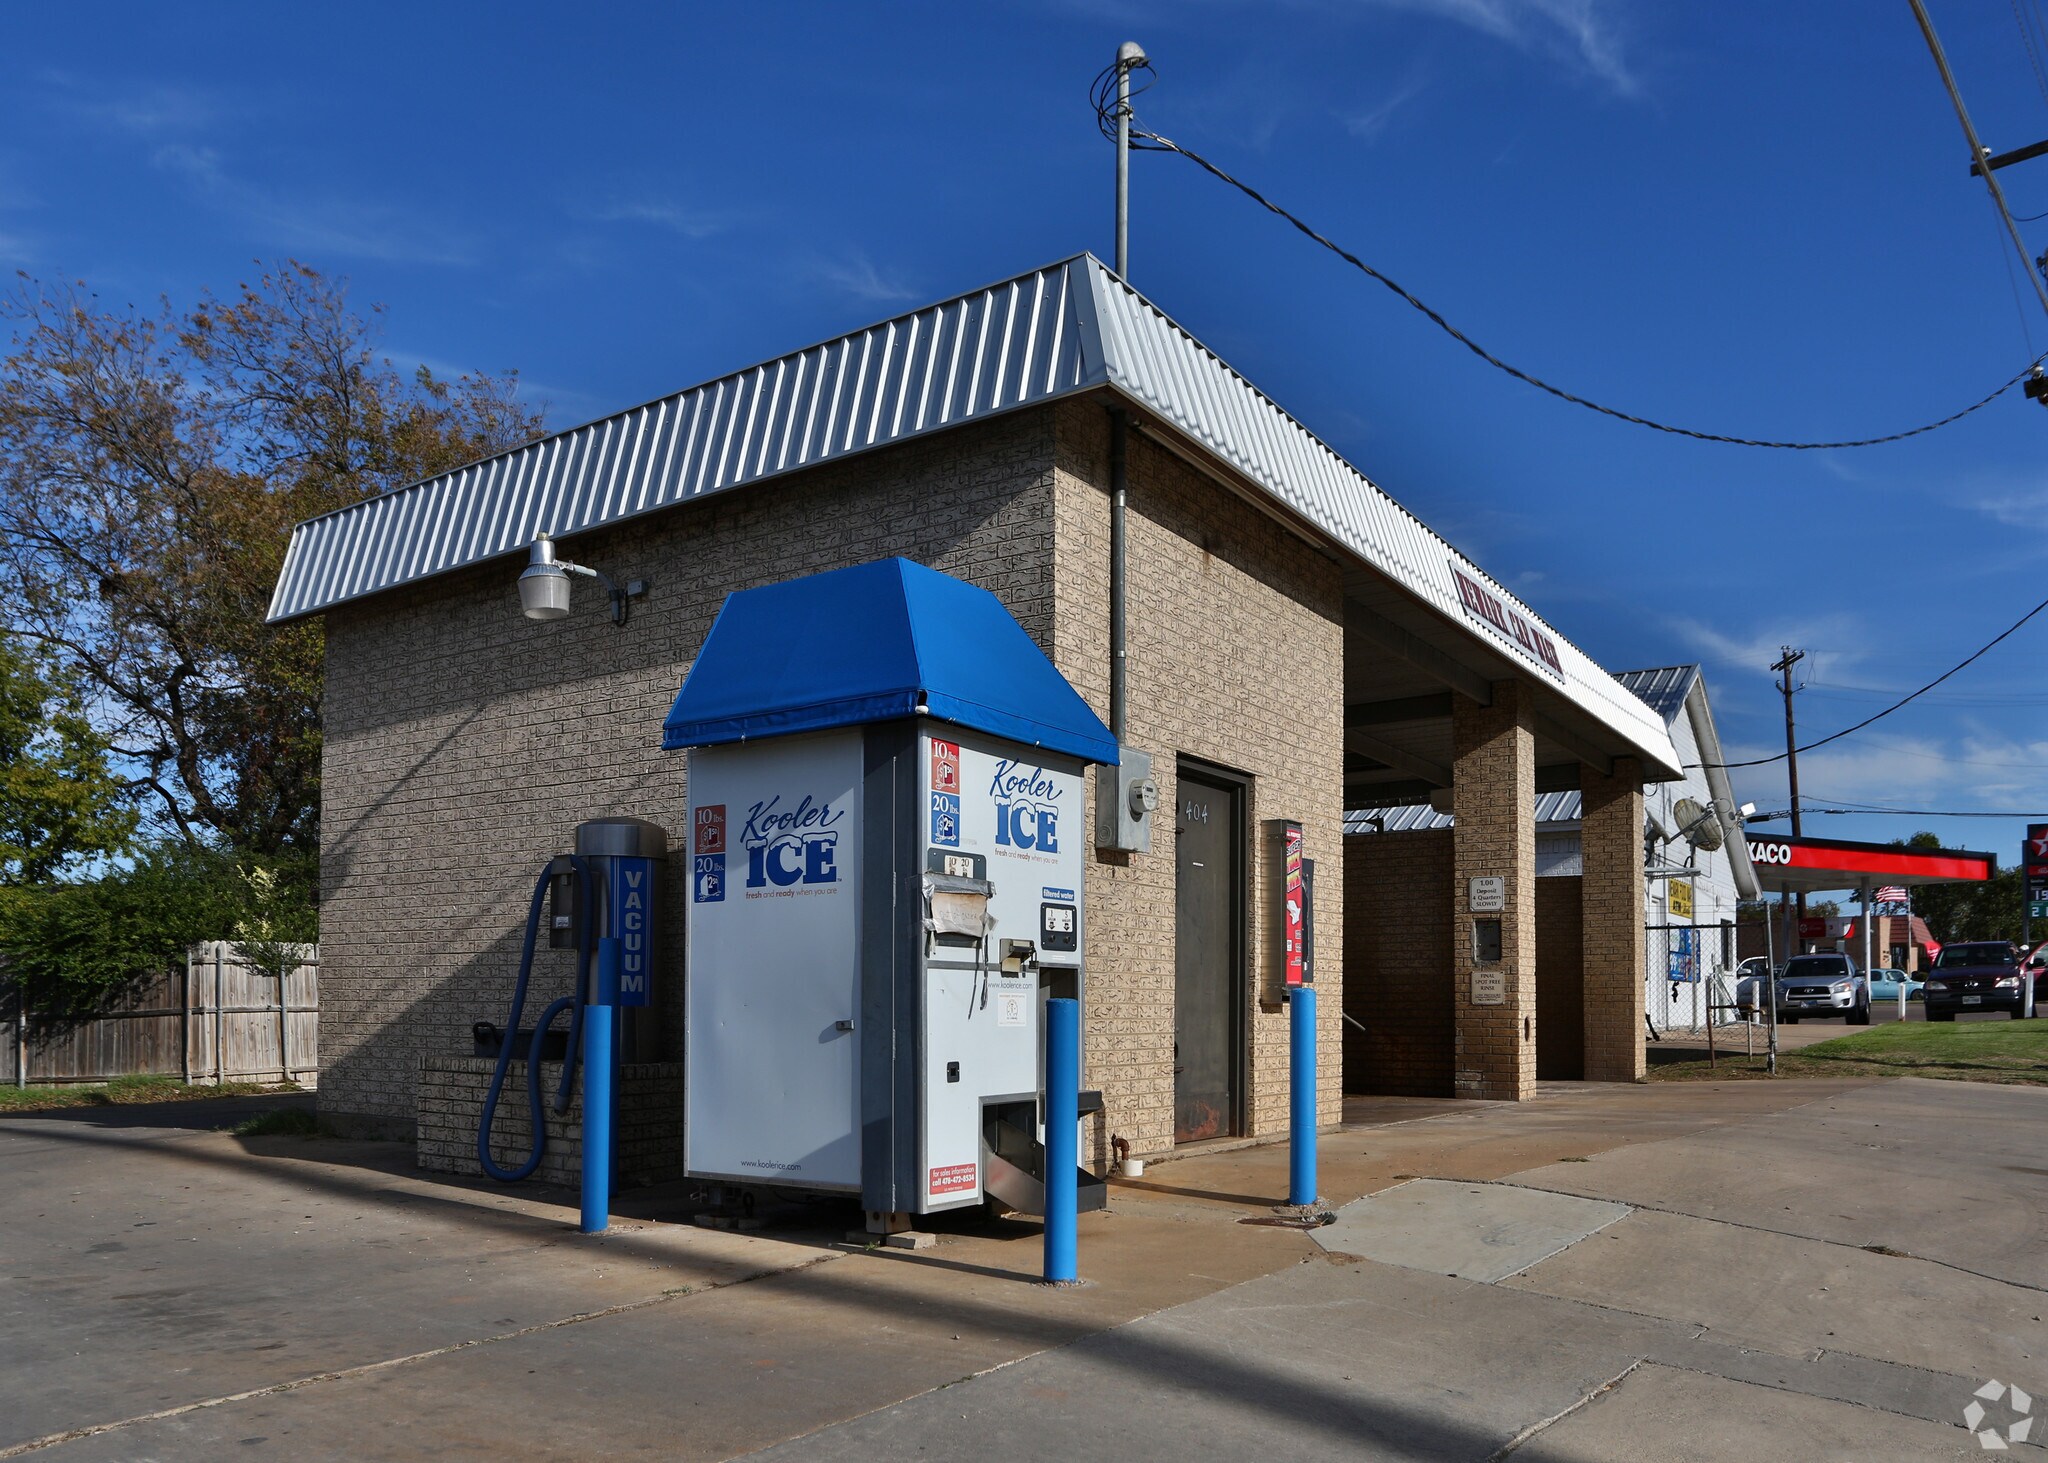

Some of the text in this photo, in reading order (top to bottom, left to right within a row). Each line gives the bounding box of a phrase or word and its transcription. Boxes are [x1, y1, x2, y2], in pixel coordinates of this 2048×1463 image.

[1508, 609, 1536, 655] CAR
[1530, 626, 1564, 676] WASH
[934, 742, 948, 758] 10
[990, 758, 1062, 800] Kooler
[933, 794, 948, 812] 20
[697, 808, 712, 824] 10
[740, 795, 845, 843] Kooler
[1185, 800, 1208, 824] 404
[994, 794, 1058, 854] ICE
[746, 831, 838, 888] ICE
[994, 848, 1007, 856] fresh
[1017, 853, 1030, 862] ready
[1032, 854, 1042, 862] when
[696, 858, 713, 873] 20
[746, 891, 762, 899] fresh
[776, 889, 794, 898] ready
[796, 888, 812, 896] when
[1044, 889, 1060, 898] filtered
[1476, 888, 1497, 896] Deposit
[621, 871, 644, 992] VACUUM
[741, 1160, 801, 1170] www.koolerice.com
[952, 1166, 974, 1175] information
[932, 1178, 941, 1186] call
